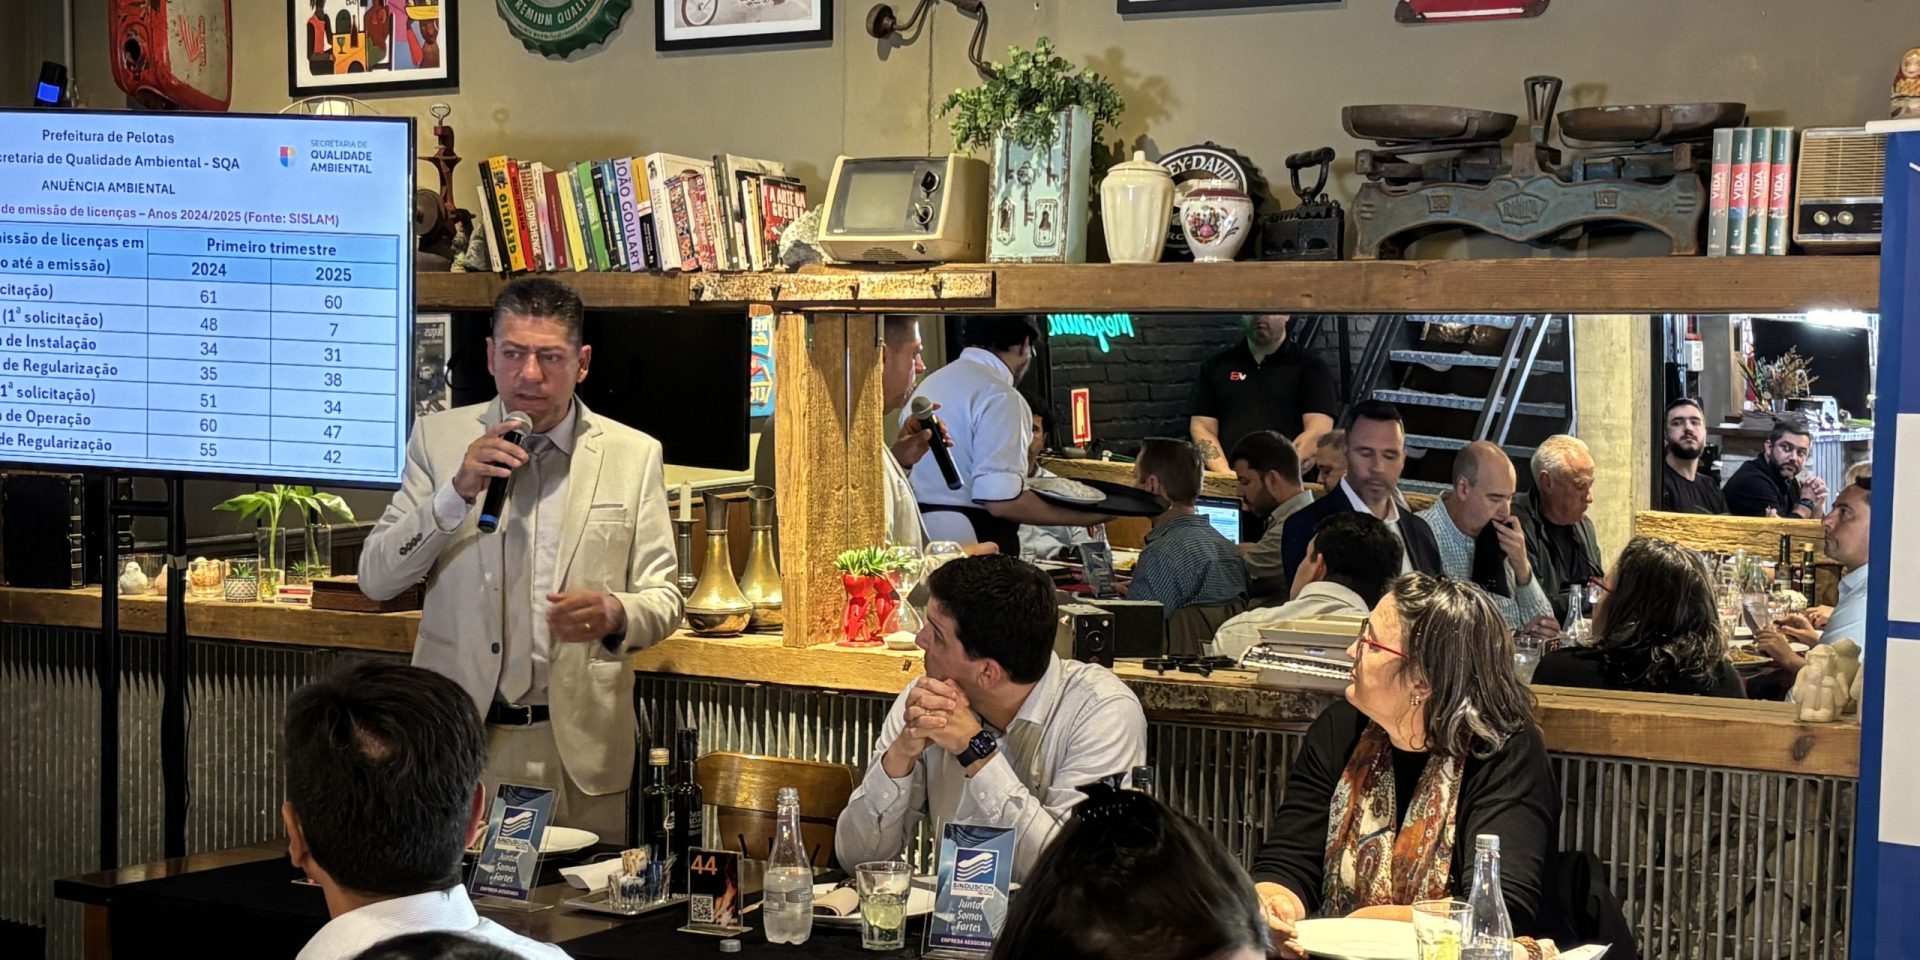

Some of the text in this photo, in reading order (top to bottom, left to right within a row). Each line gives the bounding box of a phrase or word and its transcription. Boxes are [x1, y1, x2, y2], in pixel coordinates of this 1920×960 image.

[42, 129, 175, 144] Prefeitura de Pelotas
[310, 139, 368, 148] SECRETARIA DE
[47, 153, 63, 164] de
[66, 153, 132, 167] Qualidade
[134, 155, 201, 169] Ambiental
[212, 157, 240, 171] SQA
[310, 150, 372, 161] QUALIDADE
[310, 163, 372, 174] AMBIENTAL
[42, 178, 175, 195] ANUÊNCIA AMBIENTAL
[1712, 171, 1721, 200] VIDA
[1733, 172, 1745, 201] VIDA
[1753, 170, 1764, 200] VIDA
[1773, 172, 1785, 201] VIDA
[777, 188, 794, 206] ARTE
[1, 204, 15, 214] de
[18, 204, 67, 216] emissão
[70, 206, 84, 217] de
[87, 206, 136, 220] licenças
[148, 208, 177, 220] Anos
[180, 209, 241, 222] 2024/2025
[244, 211, 286, 224] (Fonte:
[289, 213, 339, 228] SISLAM)
[615, 161, 640, 265] JOÃO GOULART
[499, 194, 516, 254] GETULIO
[526, 200, 542, 256] STONEHENGE
[0, 231, 144, 250] issão de licenças em
[207, 238, 337, 256] Primeiro trimestre
[12, 257, 33, 269] até
[37, 260, 44, 269] a
[48, 258, 110, 276] emissão)
[192, 262, 227, 278] 2024
[315, 267, 352, 282] 2025
[0, 283, 53, 300] citação)
[200, 290, 217, 304] 61
[324, 295, 343, 310] 60
[3, 306, 103, 329] (1ª solicitação)
[200, 317, 218, 331] 48
[329, 323, 338, 337] 7
[6, 333, 97, 352] de Instalação
[200, 342, 218, 356] 34
[324, 348, 342, 362] 31
[3, 357, 118, 378] de Regularização
[200, 367, 218, 381] 35
[324, 373, 342, 387] 38
[17, 385, 96, 405] solicitação)
[200, 394, 217, 408] 51
[324, 400, 342, 414] 34
[6, 409, 91, 428] de Operação
[200, 418, 218, 432] 60
[323, 425, 342, 439] 47
[17, 433, 112, 453] Regularização
[200, 443, 217, 457] 55
[323, 450, 342, 464] 42
[691, 855, 718, 875] 44
[958, 898, 984, 910] Juntos
[957, 910, 983, 921] Somos
[956, 921, 981, 932] Fortes
